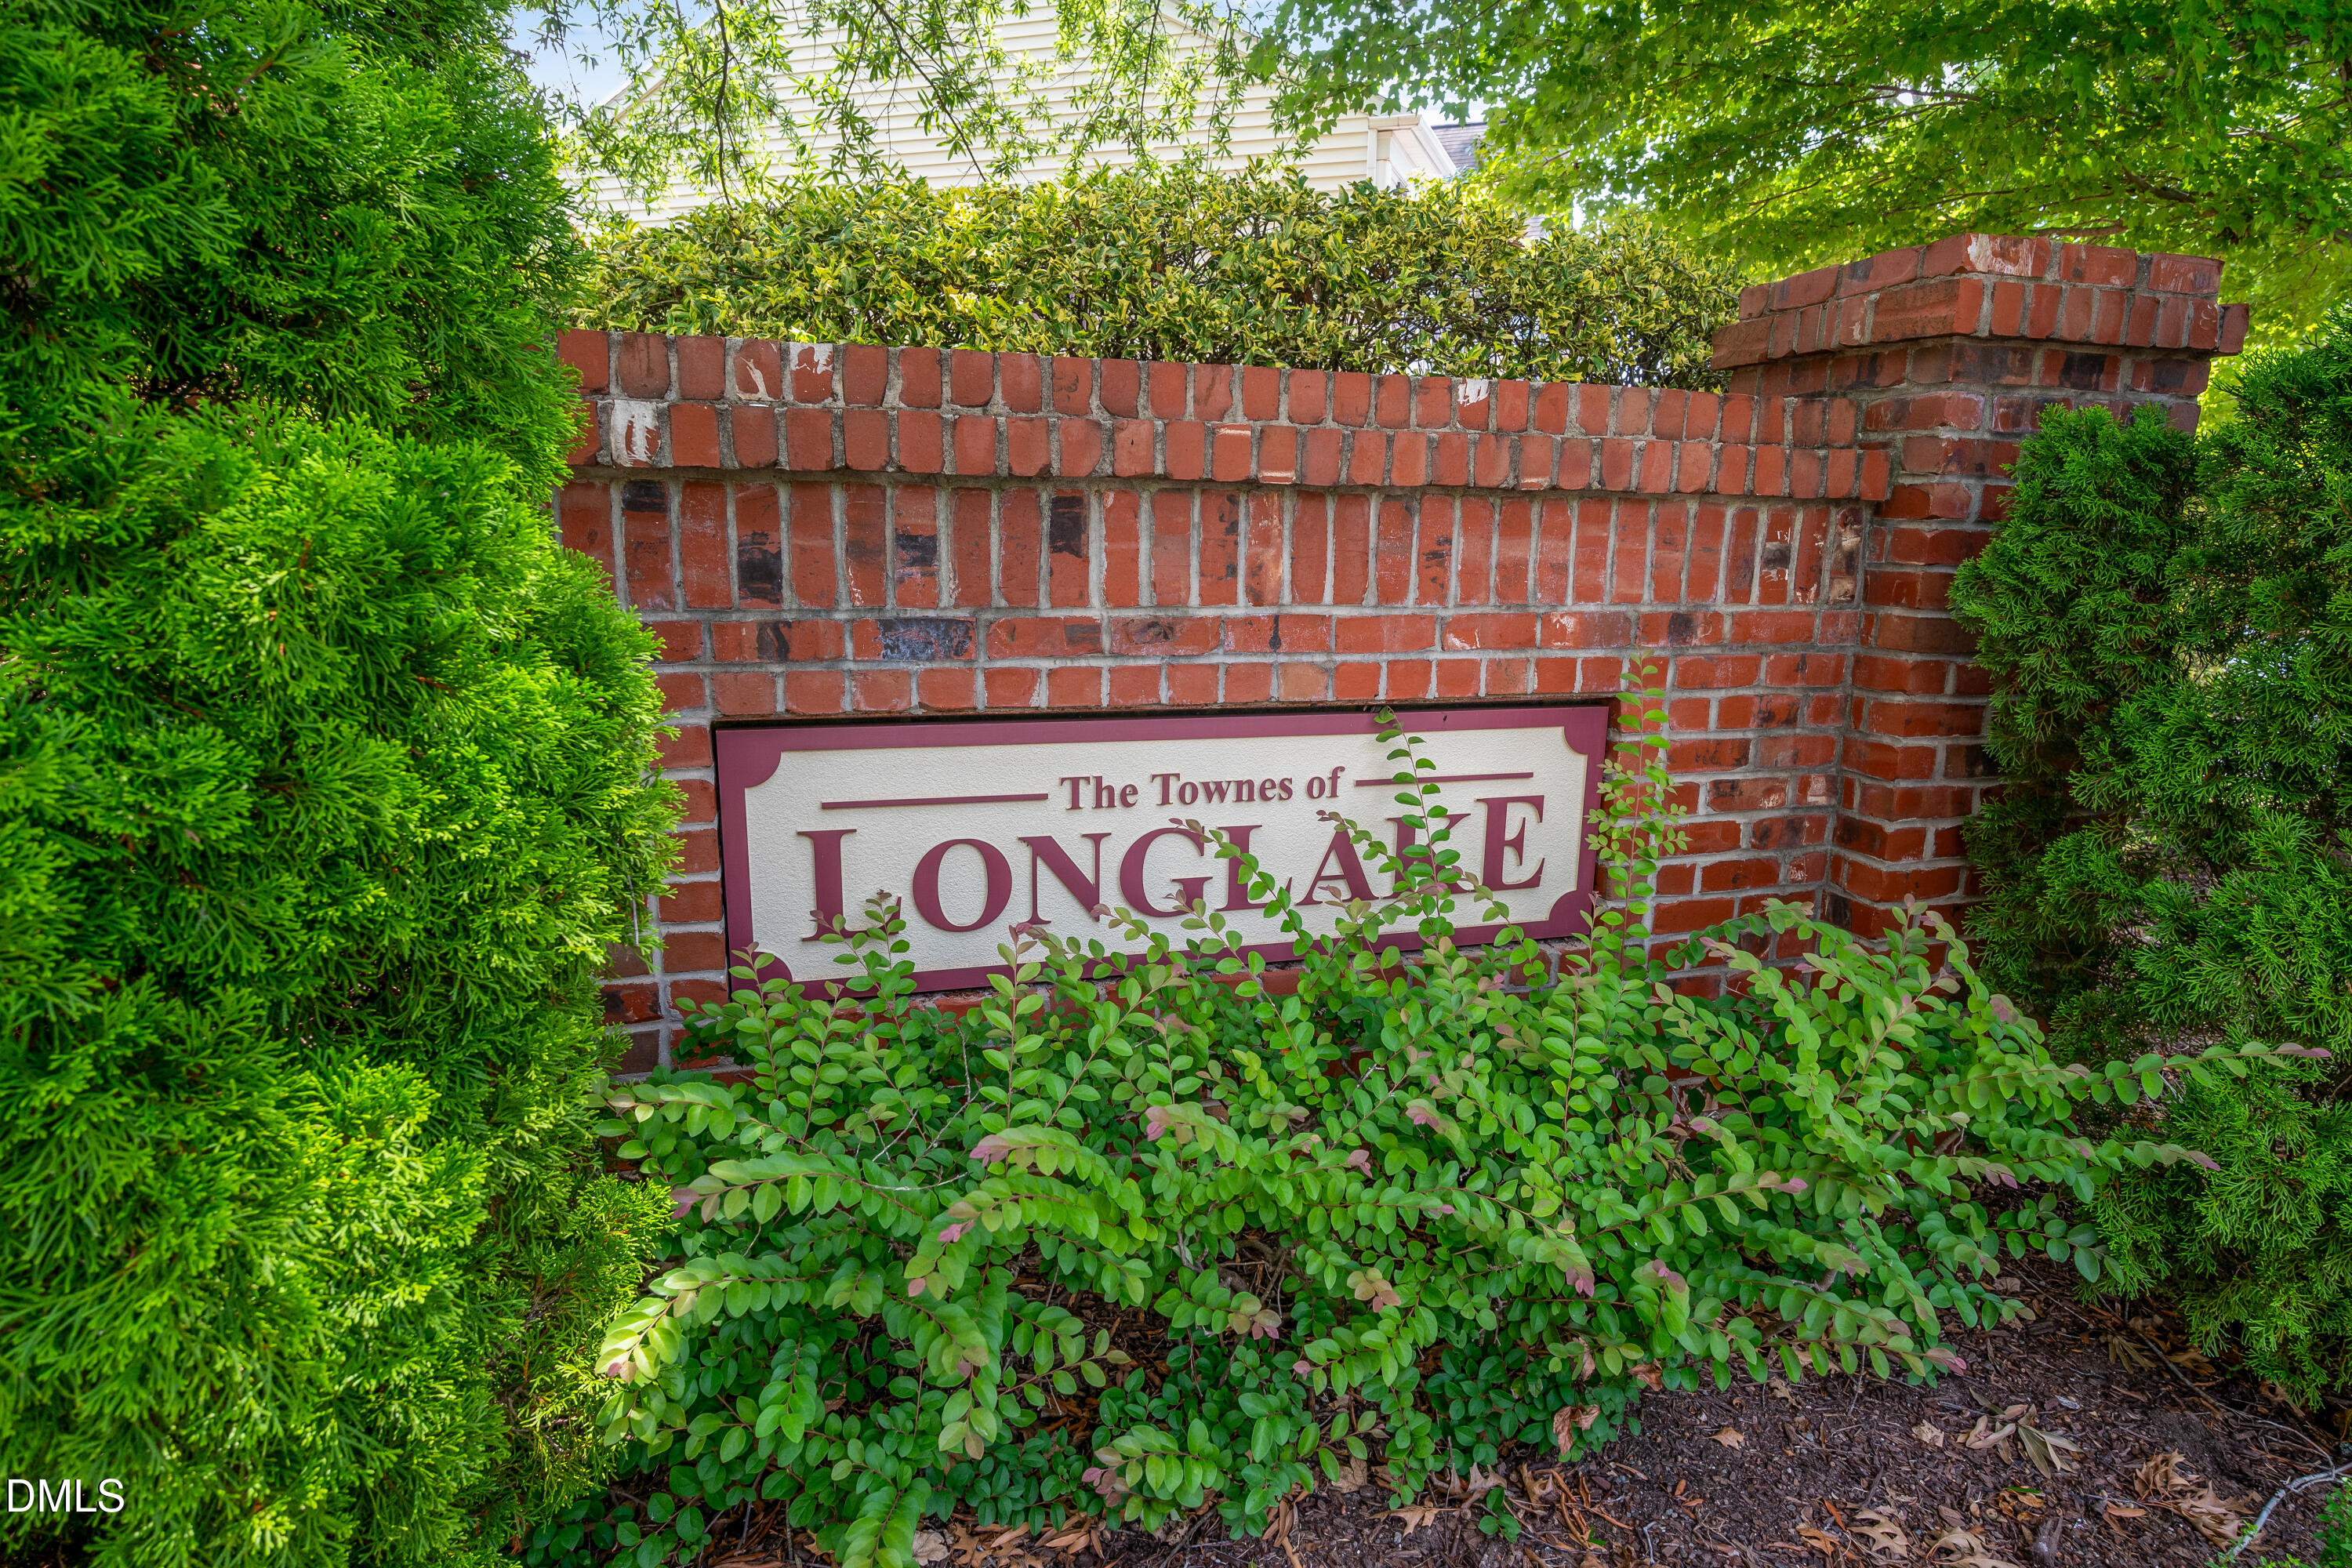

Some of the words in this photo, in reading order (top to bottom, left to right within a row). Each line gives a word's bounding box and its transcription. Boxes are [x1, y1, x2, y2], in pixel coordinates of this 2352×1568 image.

[1060, 775, 1138, 810] The
[1152, 772, 1293, 806] Townes
[1306, 766, 1346, 799] of
[797, 795, 1545, 942] LONGLAKE
